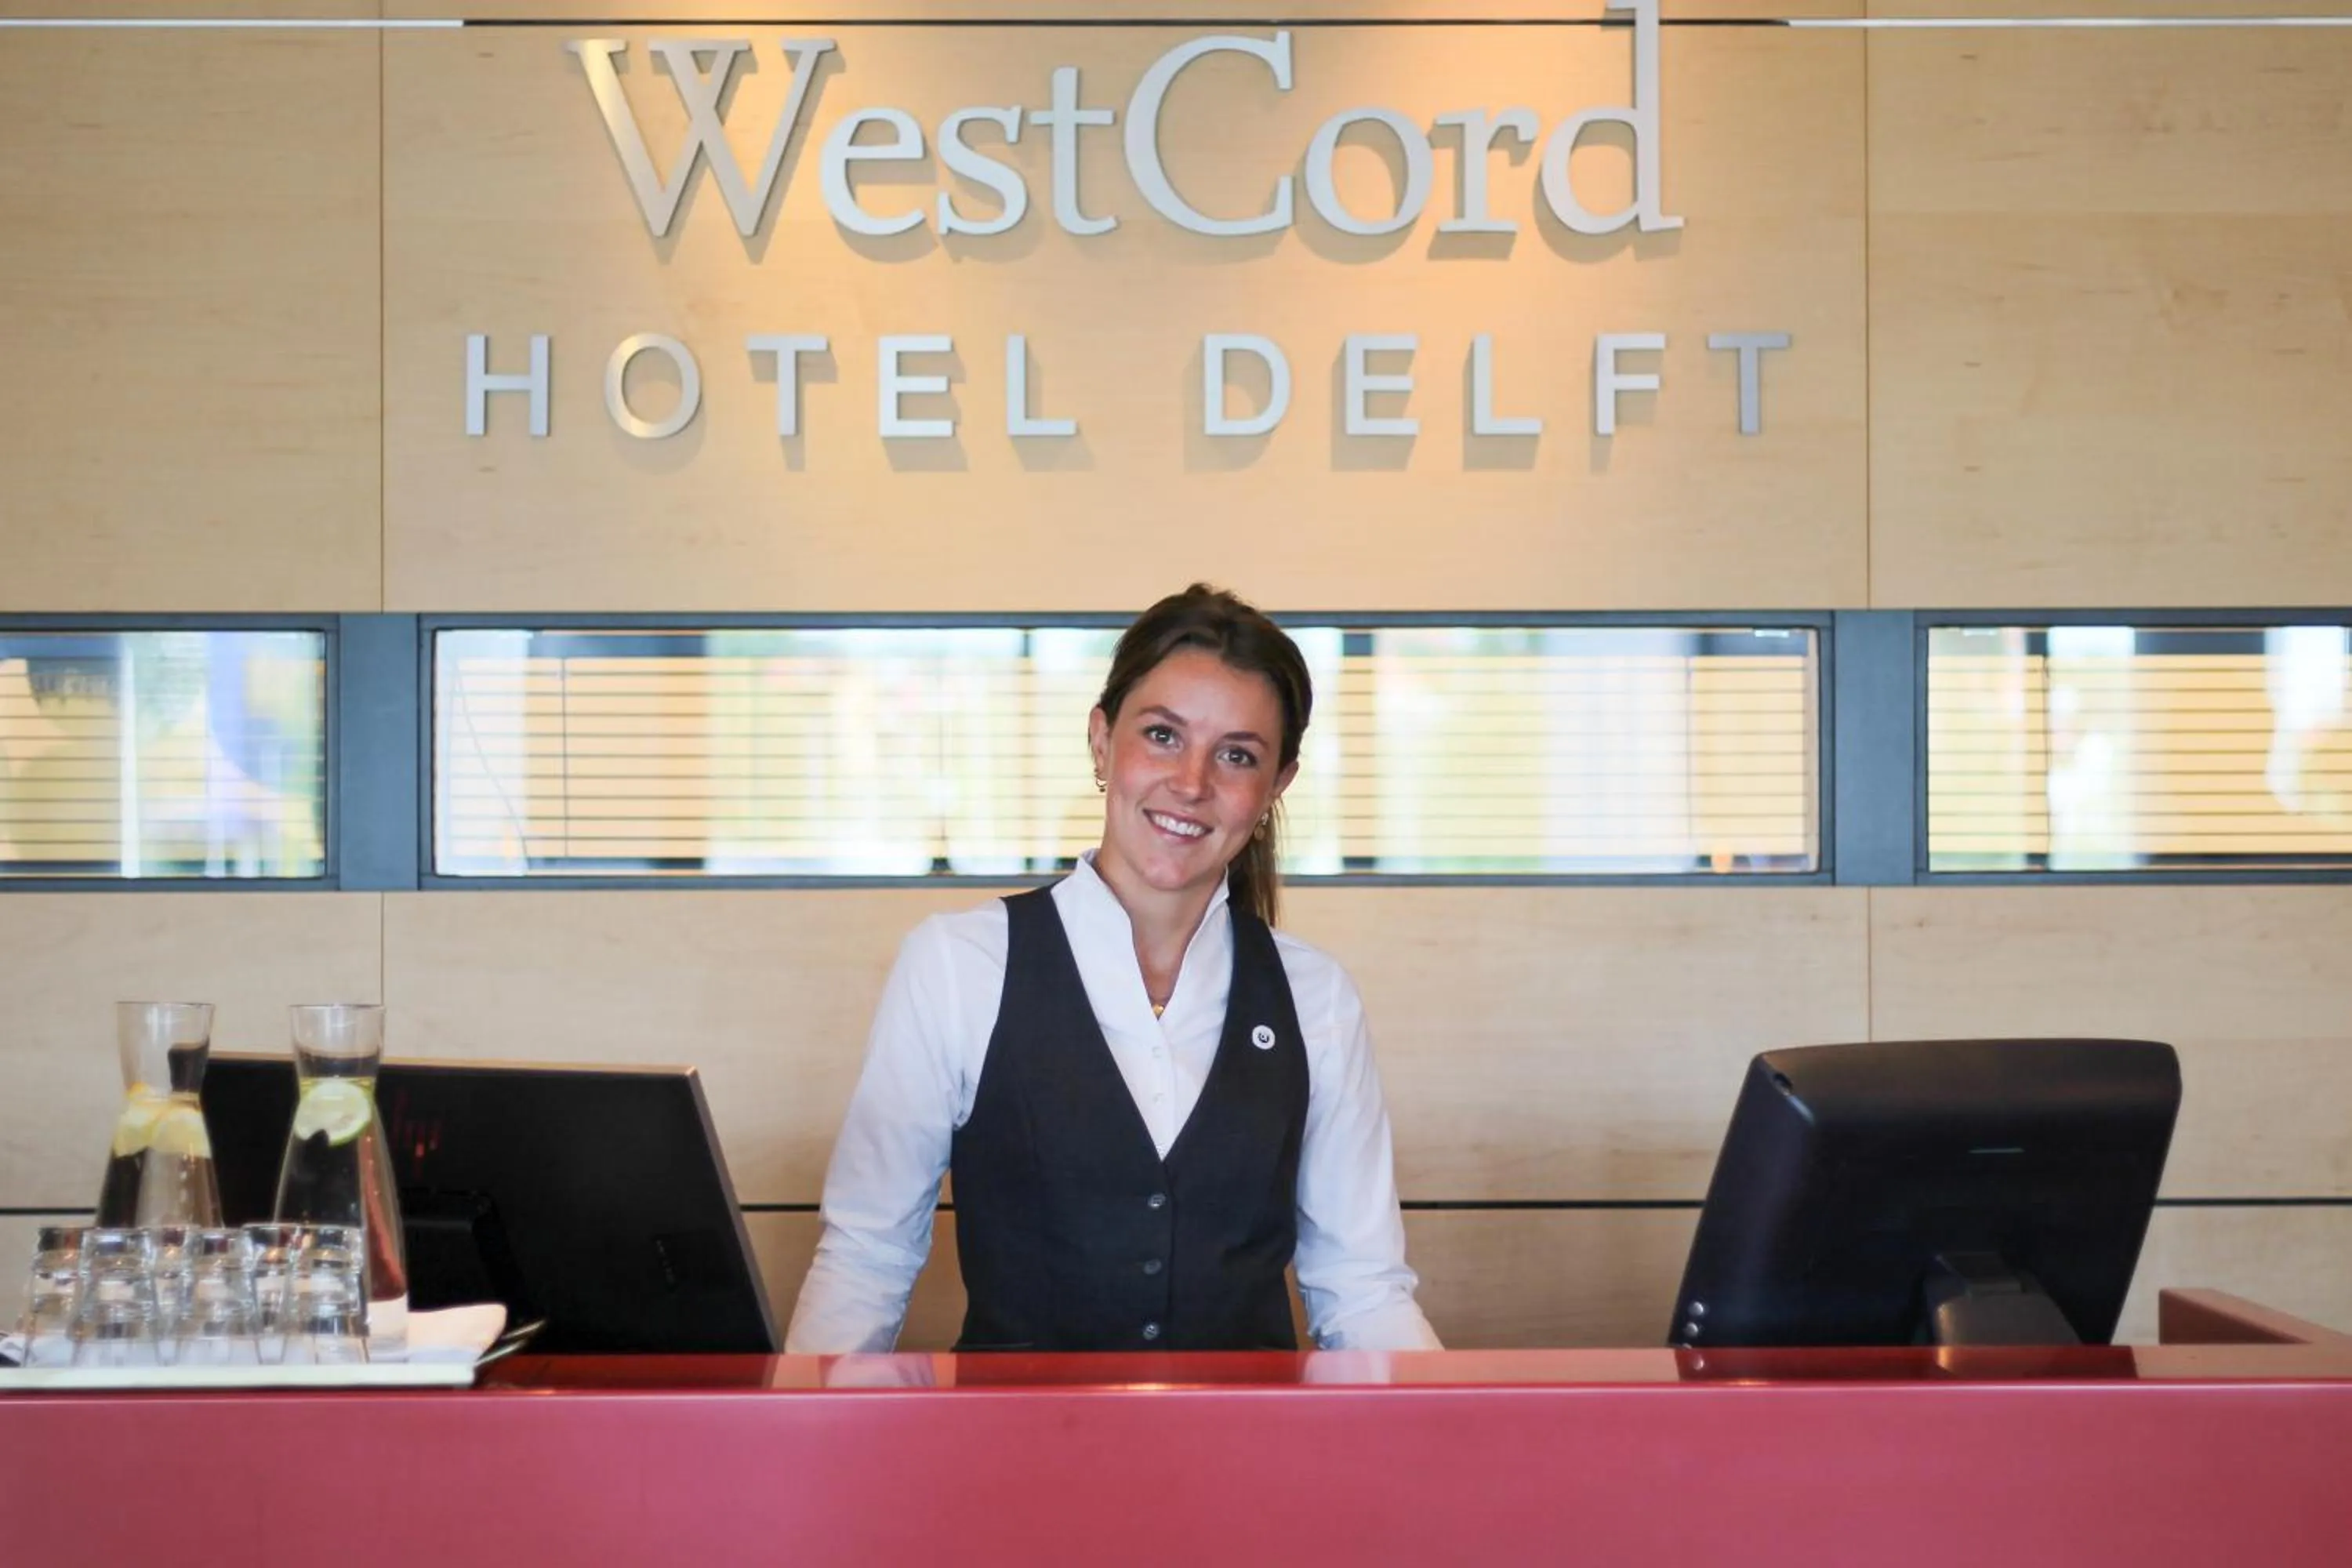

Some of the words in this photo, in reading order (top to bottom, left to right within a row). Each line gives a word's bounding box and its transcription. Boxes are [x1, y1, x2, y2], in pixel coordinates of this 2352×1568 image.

[567, 0, 1685, 237] WestCord
[465, 332, 1077, 440] HOTEL
[1203, 332, 1792, 436] DELFT
